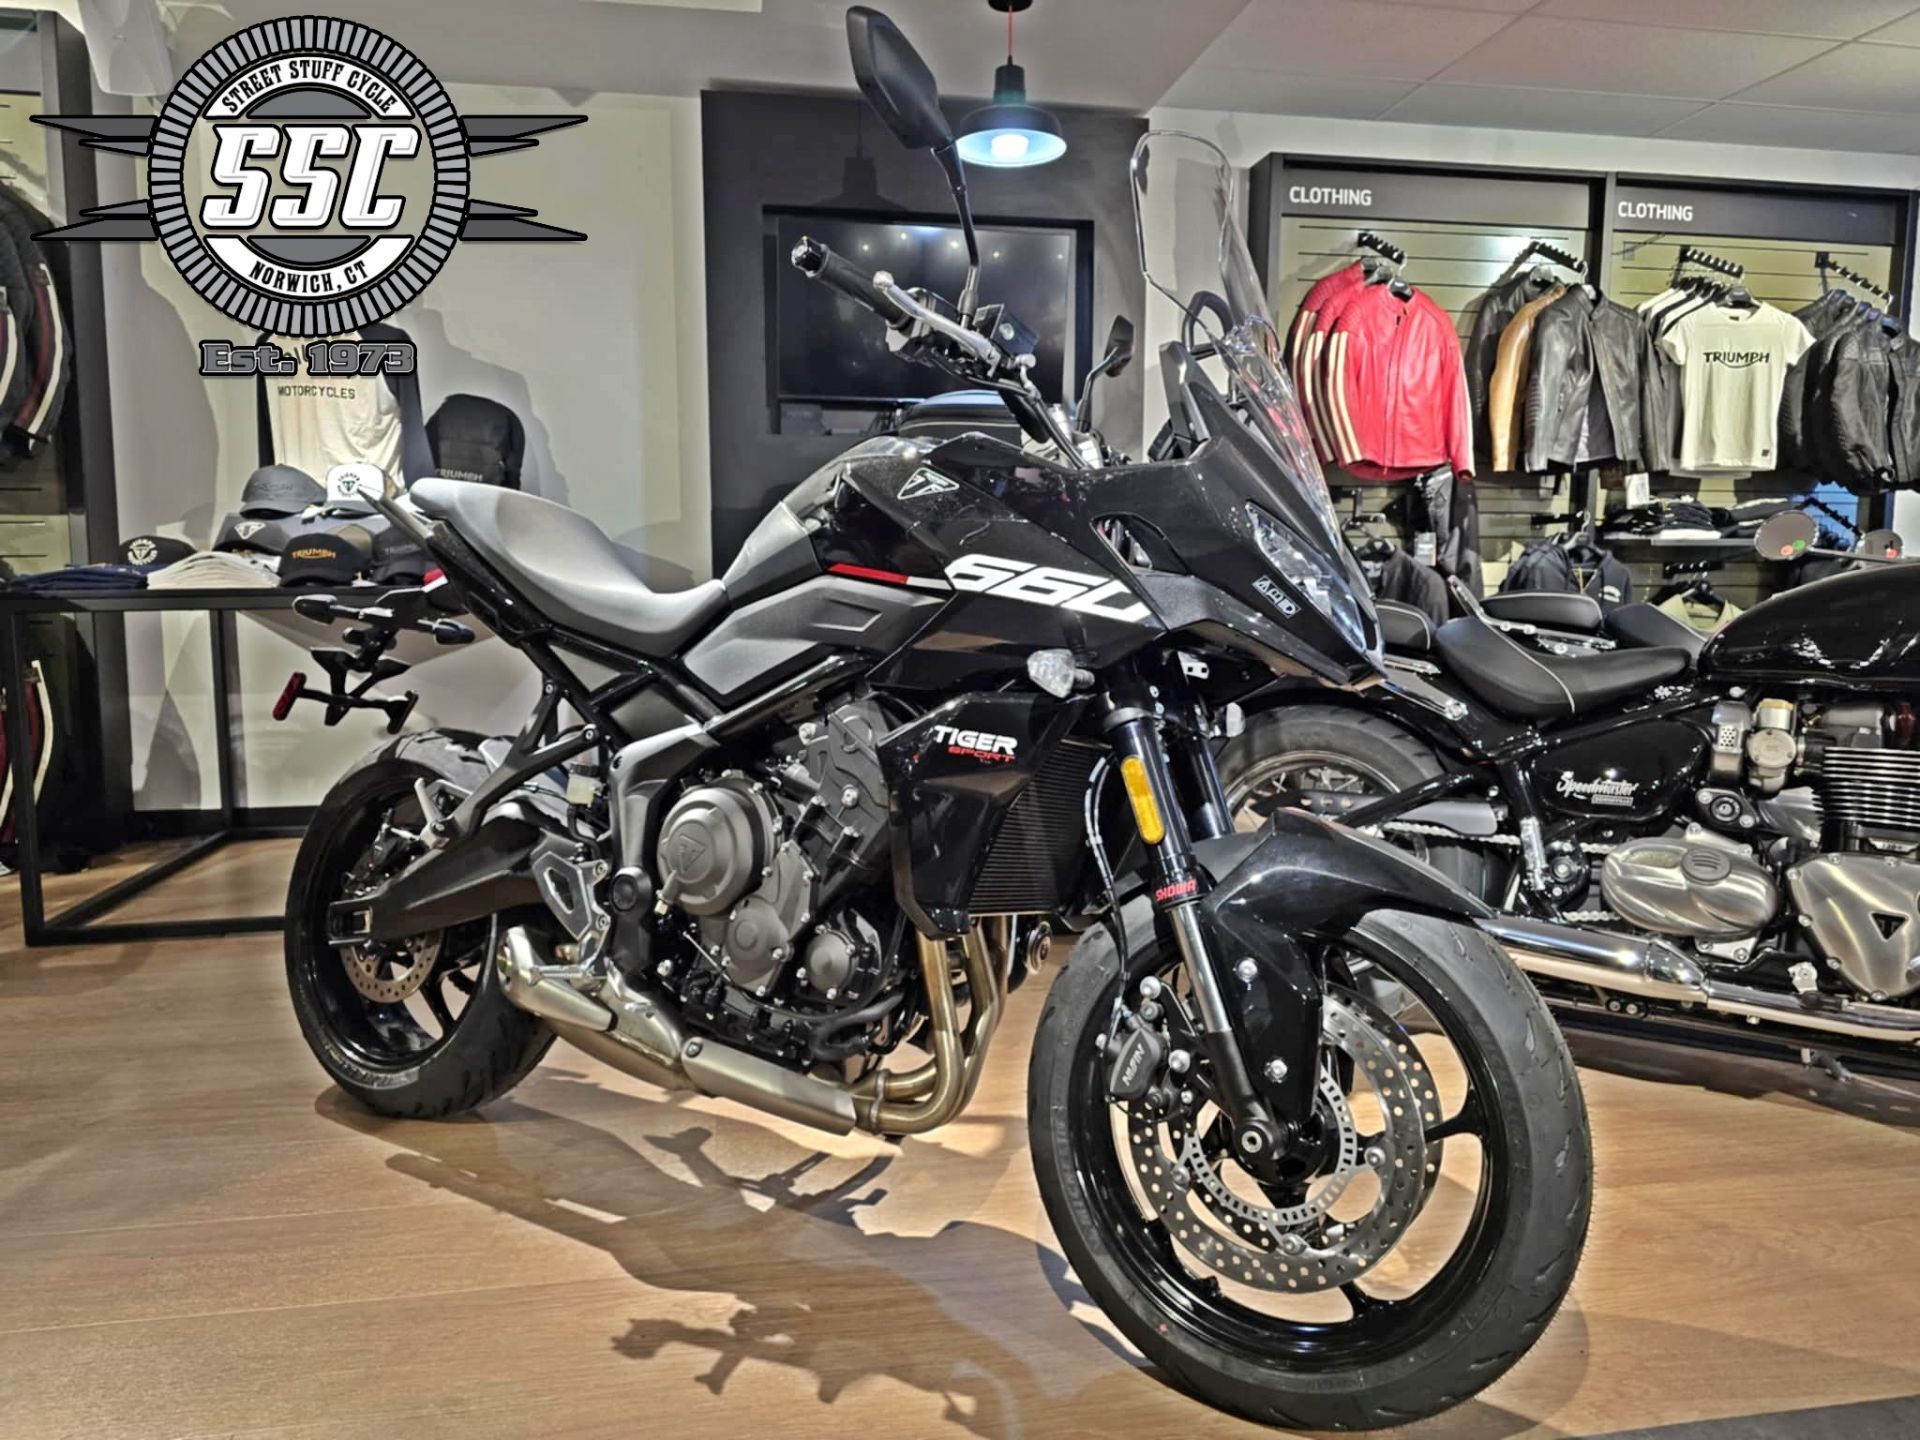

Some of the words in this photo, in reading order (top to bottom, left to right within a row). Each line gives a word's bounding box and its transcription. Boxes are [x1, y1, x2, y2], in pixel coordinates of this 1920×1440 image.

[1289, 185, 1373, 207] CLOTHING
[1617, 200, 1694, 222] CLOTHING
[1703, 351, 1771, 367] TRIUMPH
[277, 384, 356, 400] MOTORCYCLES
[291, 547, 337, 560] TRIUMPH
[933, 724, 1018, 756] TIGER
[948, 745, 1016, 763] SPORT
[1155, 879, 1197, 902] SHOWA
